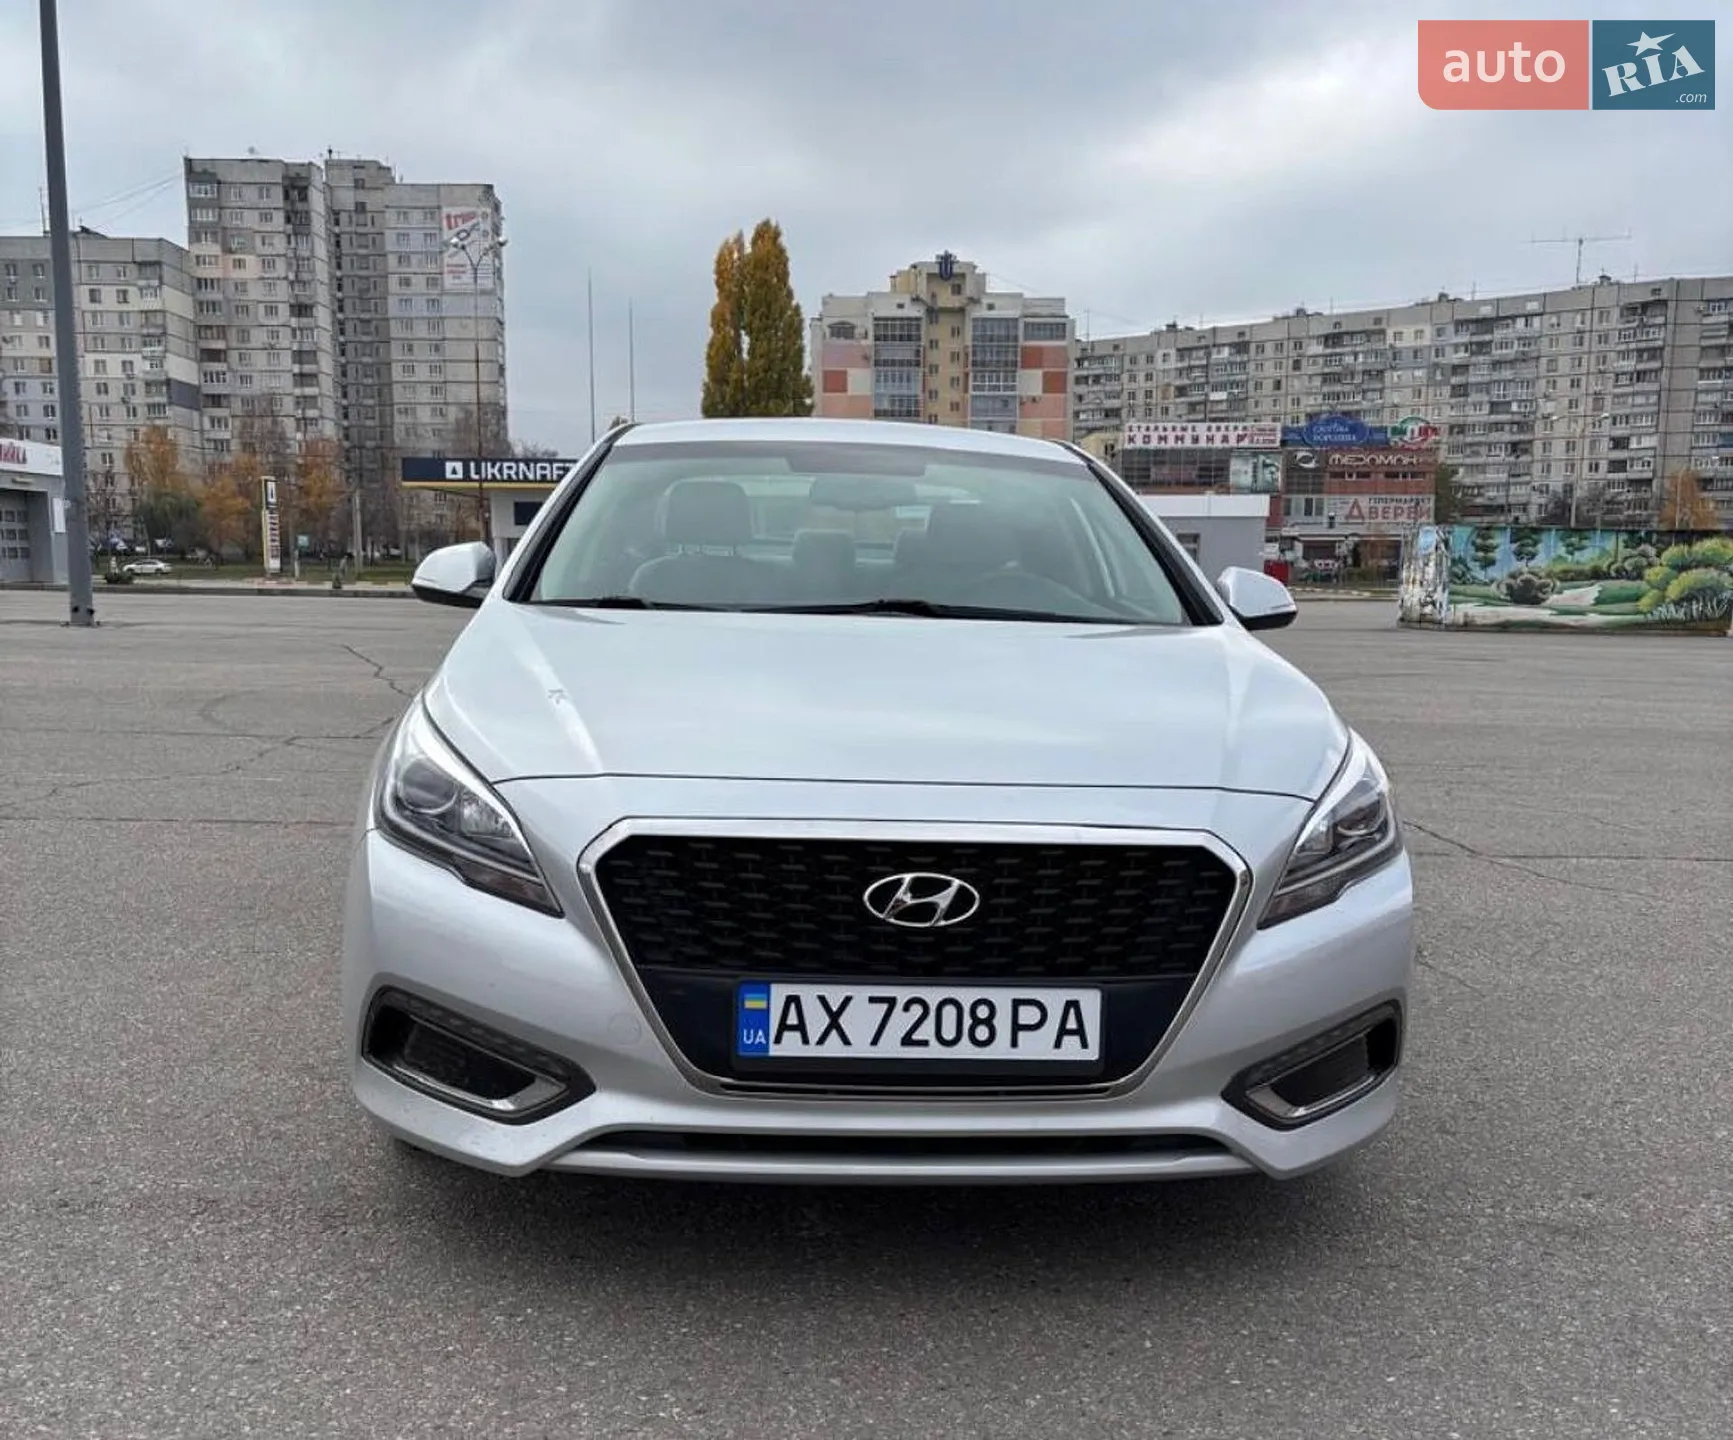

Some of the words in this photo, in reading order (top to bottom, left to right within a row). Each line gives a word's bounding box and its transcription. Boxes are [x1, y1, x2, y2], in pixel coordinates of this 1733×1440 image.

[1127, 433, 1248, 445] КОММУНАР
[773, 994, 854, 1046] AX
[867, 995, 998, 1049] 7208
[1010, 998, 1089, 1050] PA
[743, 1029, 767, 1045] UA
